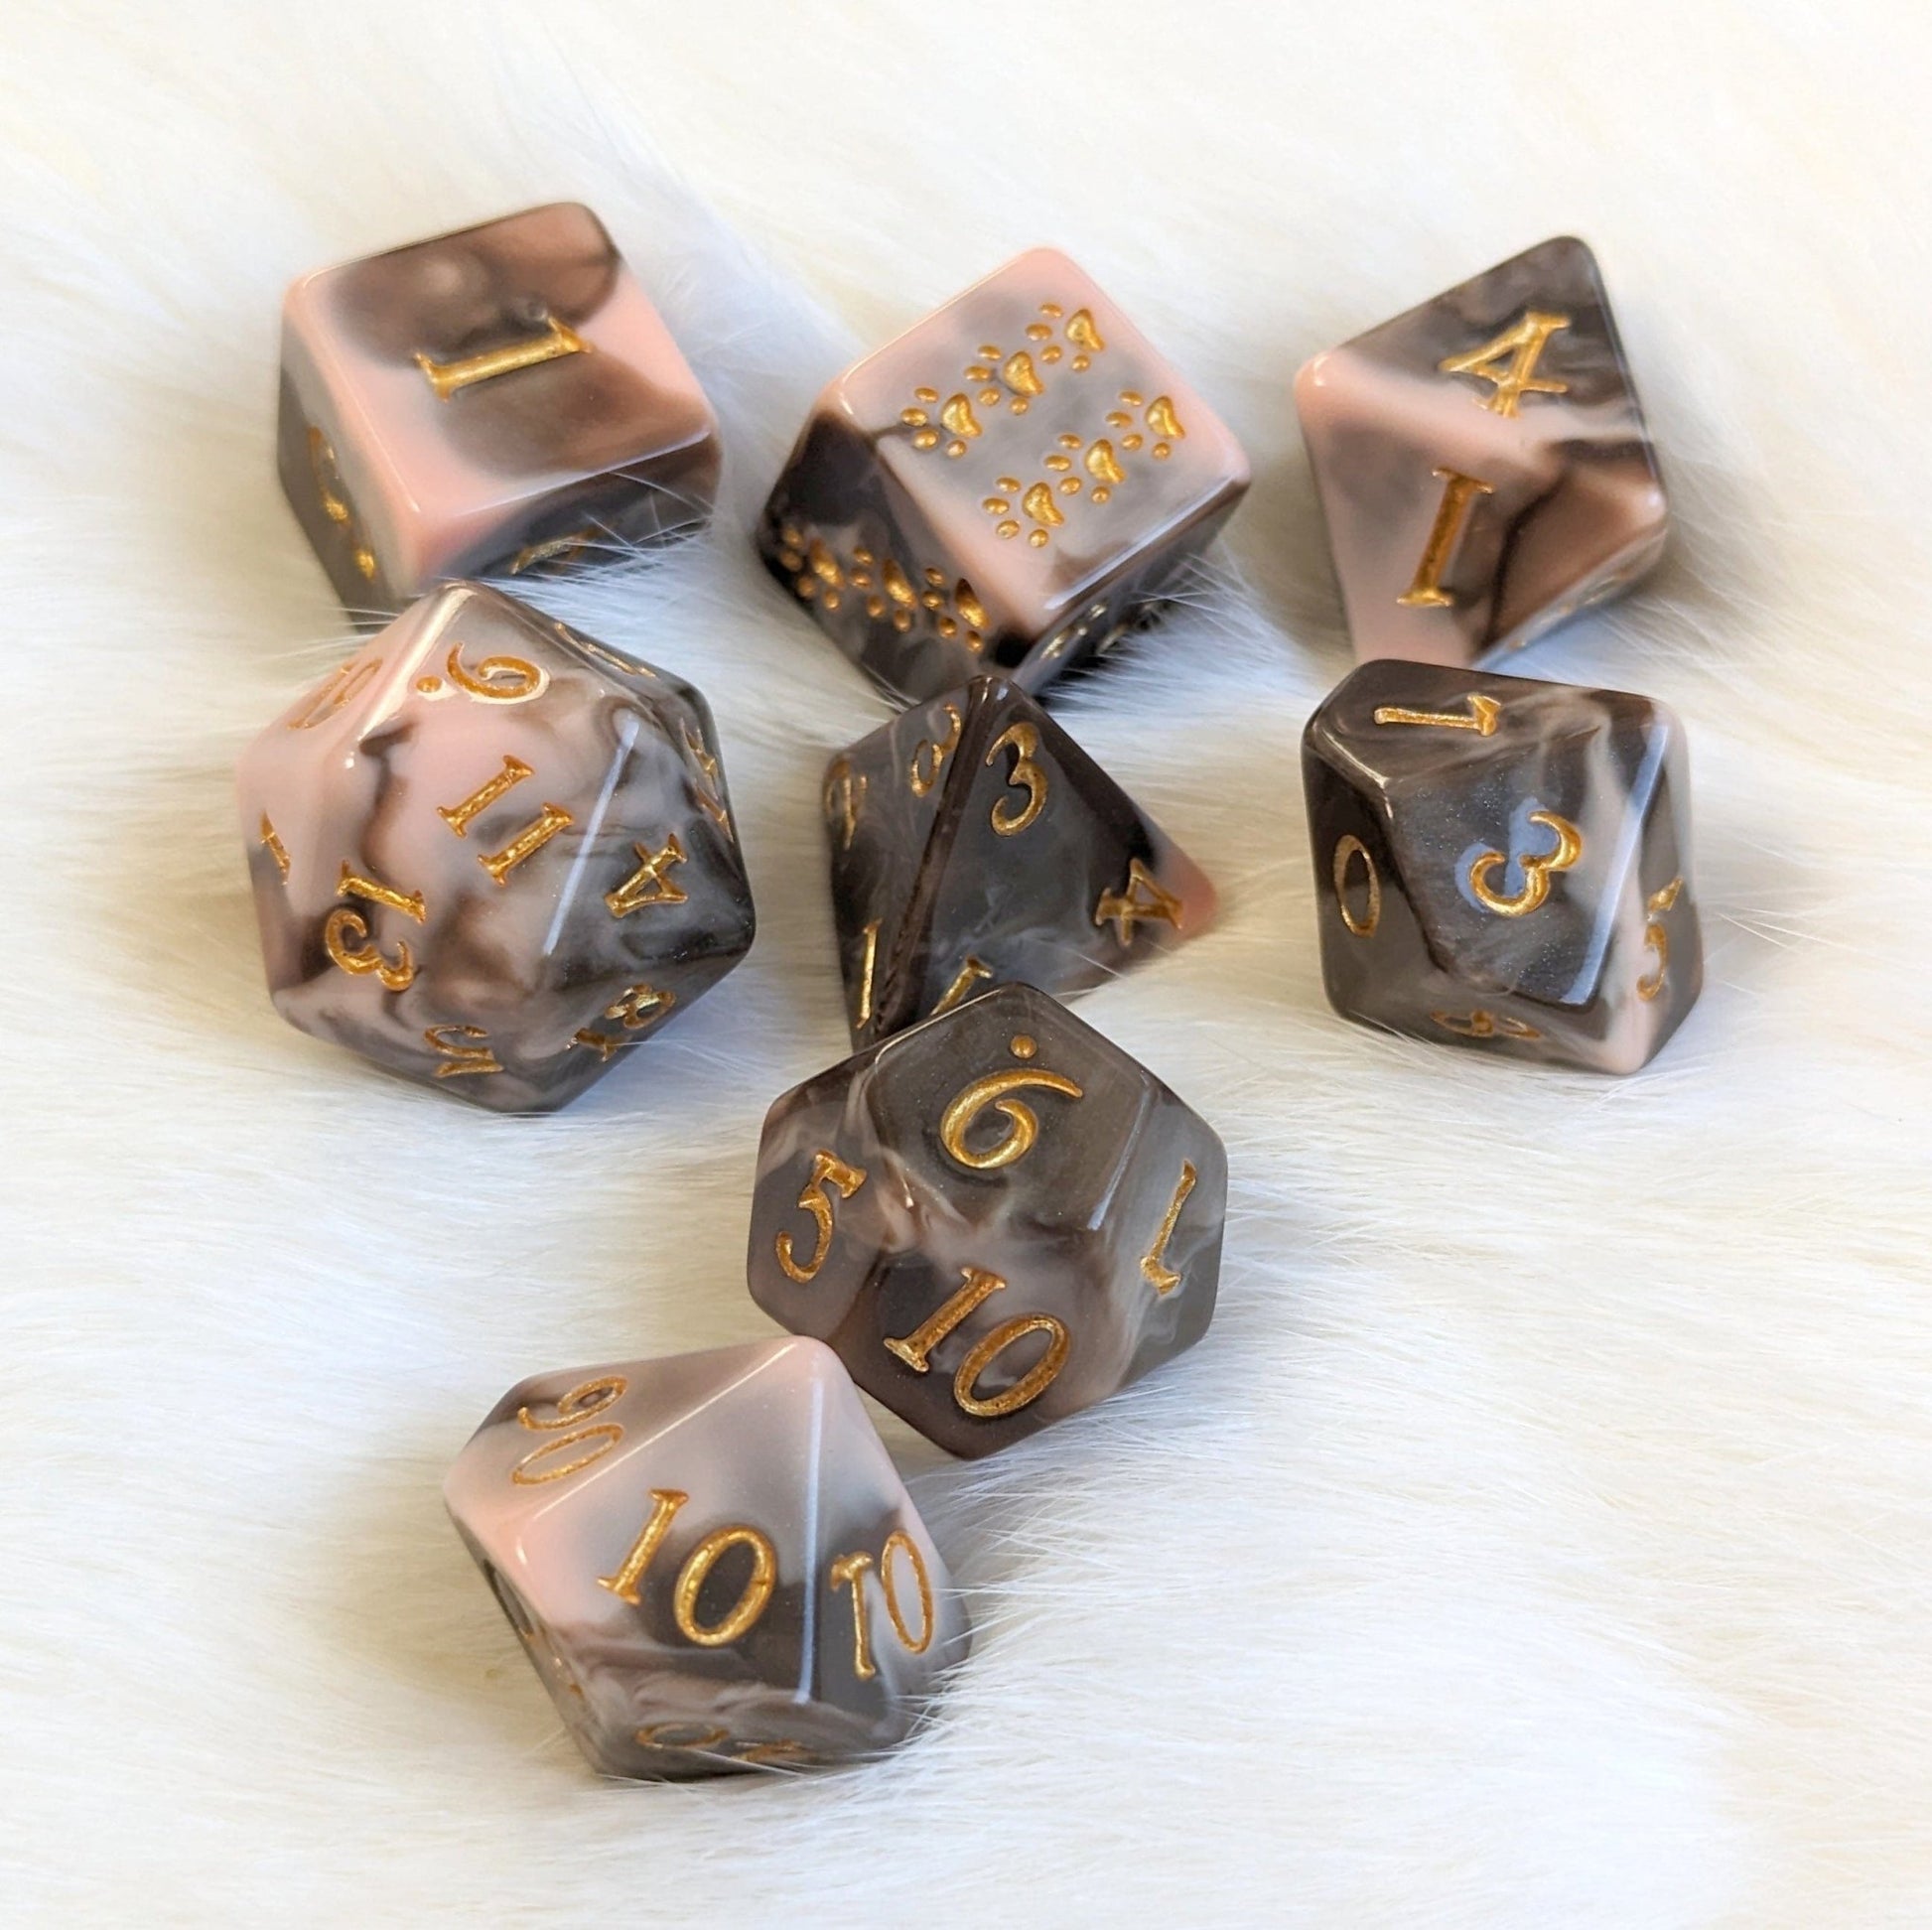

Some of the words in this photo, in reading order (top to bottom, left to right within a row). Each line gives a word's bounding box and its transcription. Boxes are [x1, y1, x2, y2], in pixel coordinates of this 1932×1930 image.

[415, 315, 592, 402] 1
[1438, 311, 1571, 418] 4
[1396, 468, 1493, 607] 1
[910, 703, 961, 797] 3
[986, 722, 1048, 836] 3
[436, 755, 574, 887] 11
[605, 833, 687, 918] 4
[1469, 810, 1582, 917] 3
[326, 859, 425, 992] 13
[1095, 858, 1183, 947] 4
[1332, 834, 1380, 938] 0
[1636, 875, 1684, 1002] 5
[775, 1149, 867, 1284] 5
[883, 1267, 1070, 1418] 10
[511, 1375, 628, 1485] 90
[598, 1489, 776, 1647] 10
